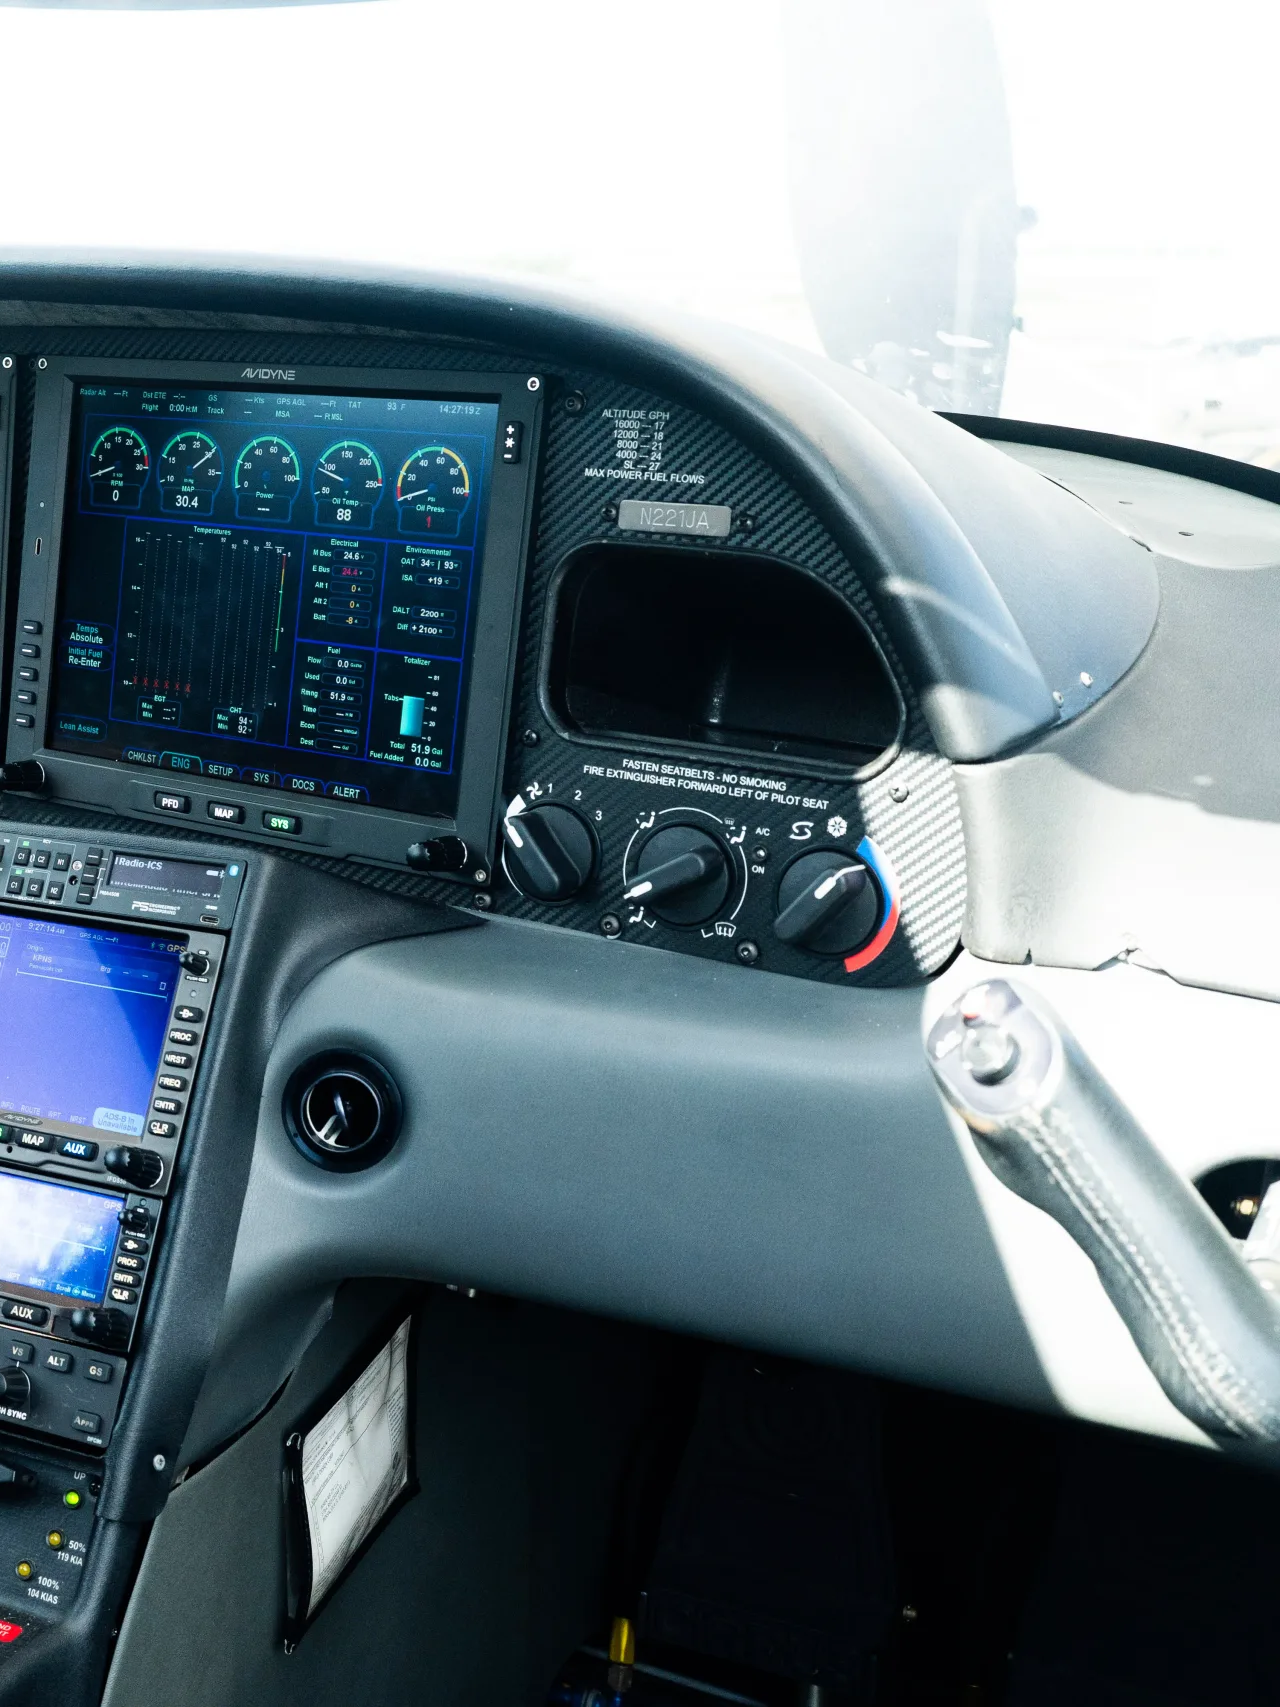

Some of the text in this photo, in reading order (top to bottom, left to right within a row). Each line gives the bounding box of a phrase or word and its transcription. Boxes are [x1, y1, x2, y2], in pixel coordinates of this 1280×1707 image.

[240, 367, 296, 382] AVIDYNE
[169, 404, 185, 412] 0:00
[207, 407, 224, 415] Track
[387, 402, 398, 411] 93
[439, 405, 474, 414] 14:27:19
[602, 409, 669, 420] ALTITUDE GPH
[614, 420, 665, 430] 16000 17
[613, 430, 663, 440] 12000 18
[616, 440, 662, 450] 8000 21
[616, 450, 661, 460] 4000 24
[624, 461, 660, 471] SL 27
[585, 468, 705, 484] MAX POWER FUEL FLOWS
[175, 496, 199, 508] 30.4
[345, 499, 359, 507] Temp
[336, 509, 352, 521] 88
[640, 507, 710, 529] N221JA
[194, 526, 231, 535] Temperatures
[331, 539, 358, 547] Electrical
[406, 546, 452, 556] Environmental
[393, 606, 410, 614] DALT
[420, 609, 439, 617] 2200
[70, 633, 103, 644] Absolute
[69, 647, 103, 658] Initial Fuel
[327, 647, 340, 655] Fuel
[69, 656, 101, 667] Re-Enter
[404, 656, 431, 666] Totalizer
[60, 721, 99, 735] Lean Assist
[390, 741, 405, 749] Total
[411, 743, 430, 754] 51.9
[128, 751, 156, 764] CHKLST
[171, 757, 190, 769] ENG
[208, 765, 233, 777] SETUP
[623, 759, 787, 791] FASTEN SEATBELTS NO SMOKING
[254, 772, 269, 783] SYS
[292, 779, 315, 791] DOCS
[584, 765, 829, 810] FIRE EXTINGUISHER FORWARD LEFT OF PILOT SEAT
[333, 786, 360, 799] ALERT
[162, 798, 178, 808] PFD
[215, 808, 233, 819] MAP
[271, 818, 289, 829] SYS
[755, 826, 771, 837] A/C
[751, 865, 765, 875] ON
[170, 1031, 191, 1041] PROC
[159, 1077, 181, 1088] FREQ
[154, 1100, 175, 1111] ENTR
[97, 1118, 138, 1132] Unavailable
[22, 1133, 44, 1147] MAP
[64, 1141, 85, 1156] AUX
[10, 1306, 33, 1320] AUX
[47, 1355, 65, 1367] ALT
[6, 1407, 27, 1420] SYNC
[37, 1576, 59, 1590] 100%
[27, 1587, 58, 1605] 104 KIAS
